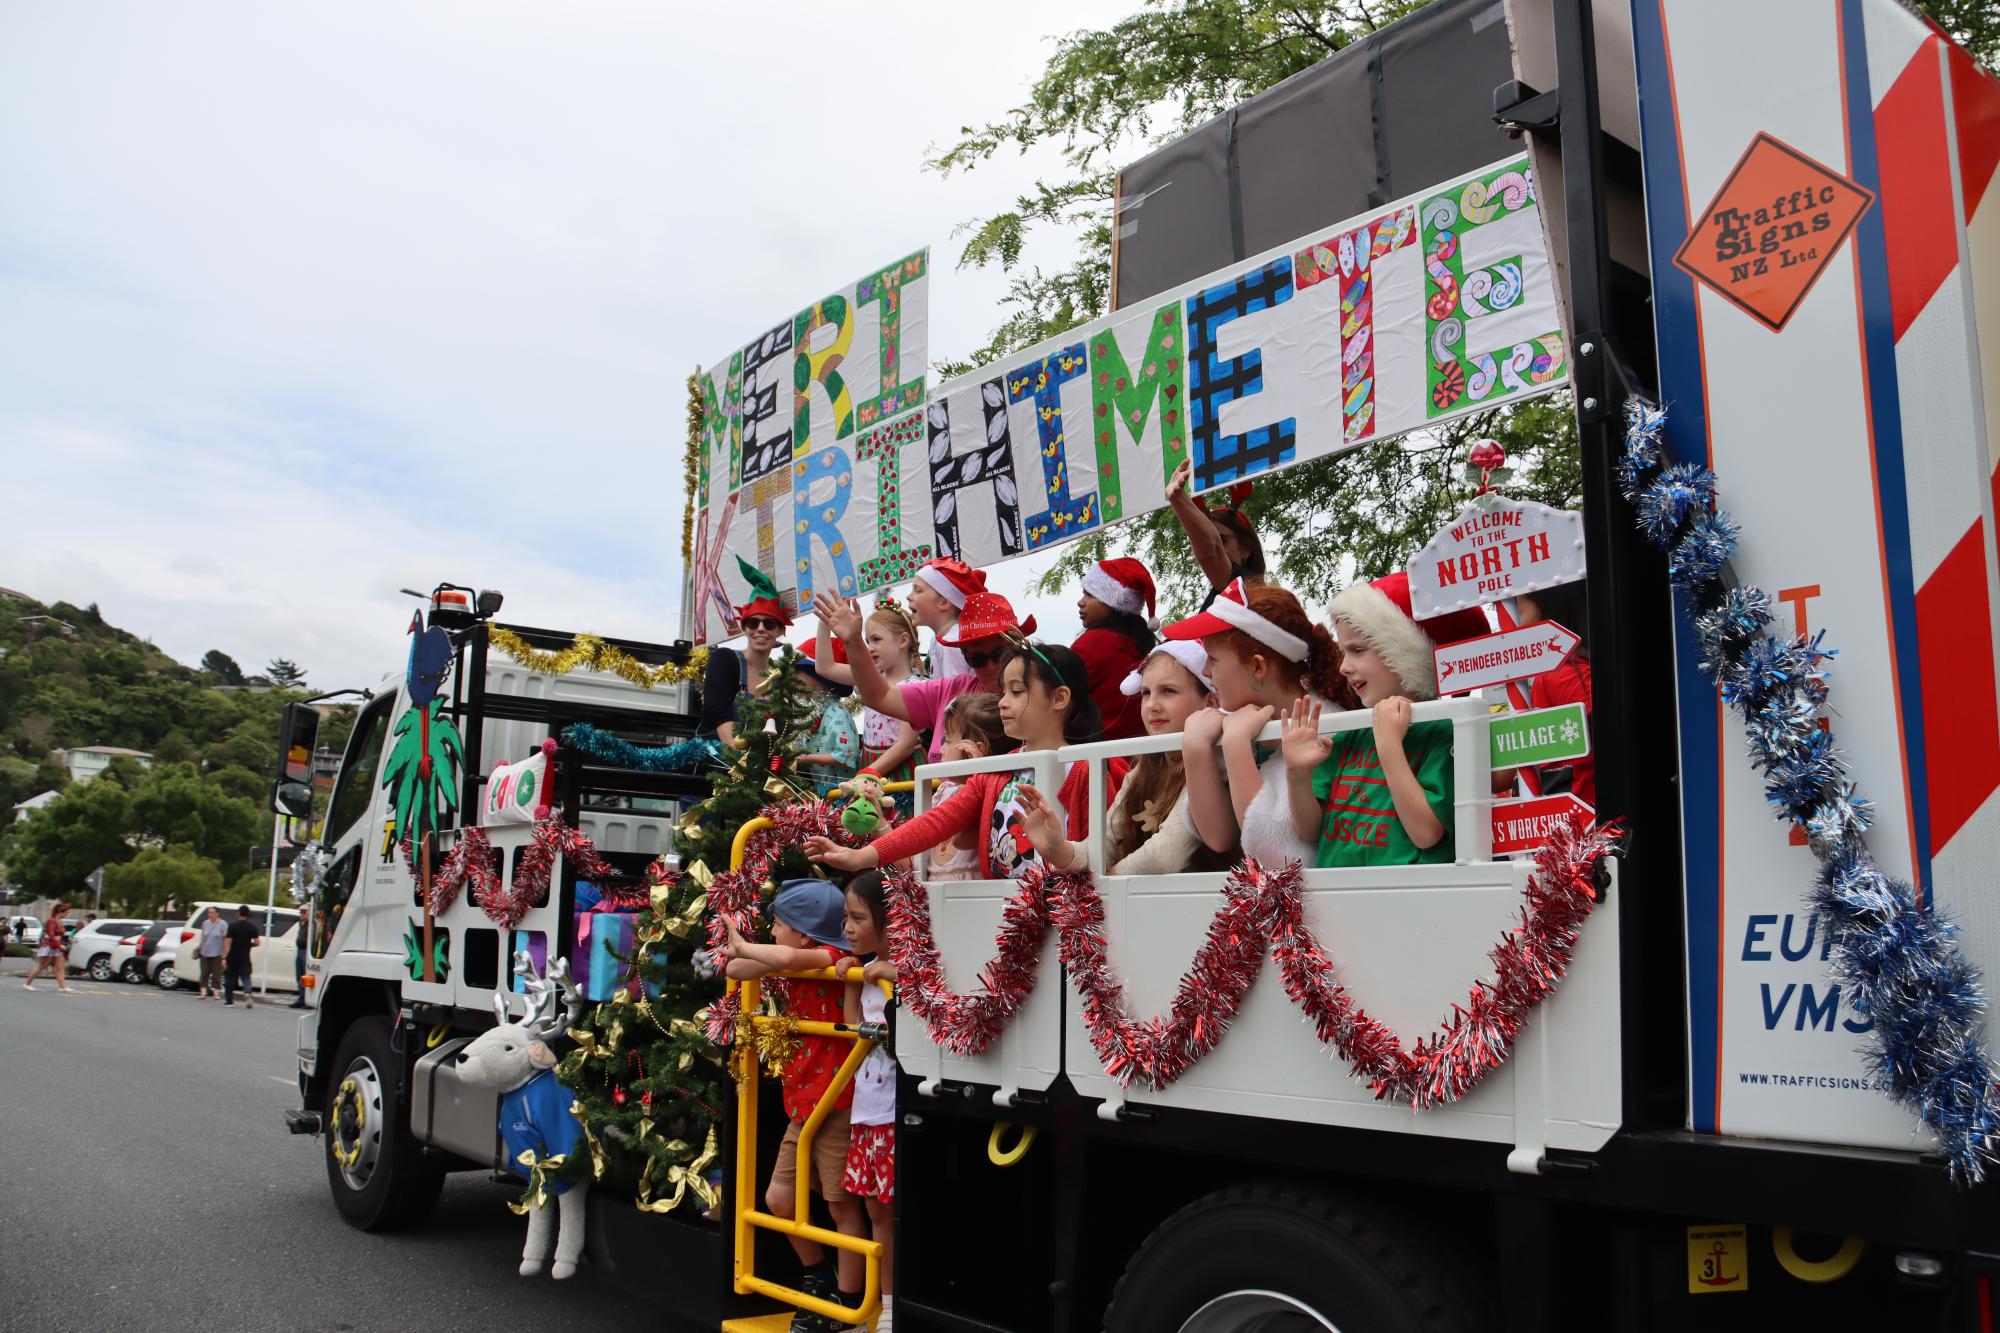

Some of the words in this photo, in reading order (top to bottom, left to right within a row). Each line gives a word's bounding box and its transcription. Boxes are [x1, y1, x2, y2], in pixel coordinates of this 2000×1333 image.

[1713, 185, 1835, 233] Traffic
[1715, 211, 1832, 263] Signs
[1729, 256, 1769, 284] NZ
[1779, 247, 1818, 269] Ltd
[700, 249, 927, 506] MERI
[1450, 511, 1524, 543] WELCOME
[1471, 535, 1484, 548] TO
[1486, 528, 1508, 543] THE
[1436, 531, 1551, 588] NORTH
[1477, 573, 1513, 594] POLE
[969, 620, 998, 630] Christmas
[1496, 724, 1557, 753] VILLAGE
[1325, 816, 1390, 848] USCLE
[1492, 821, 1505, 844] 'S
[1703, 1258, 1714, 1278] 3
